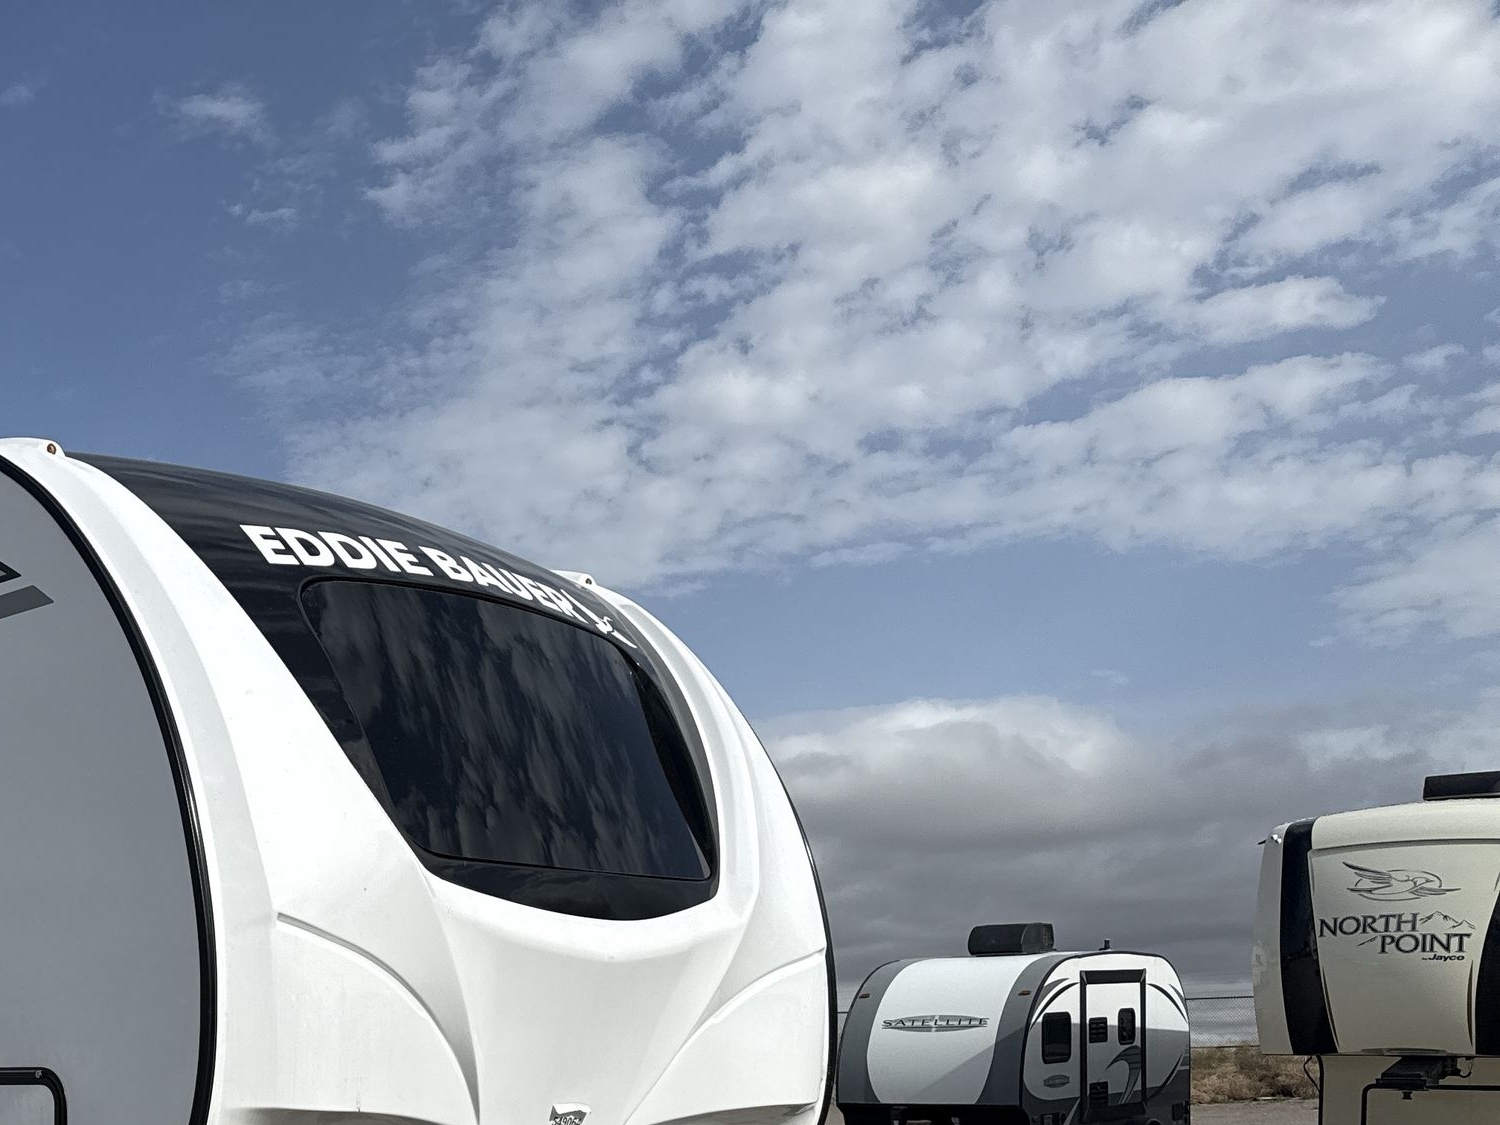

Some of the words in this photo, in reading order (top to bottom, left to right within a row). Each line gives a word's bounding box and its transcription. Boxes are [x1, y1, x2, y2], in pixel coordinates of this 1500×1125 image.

[240, 524, 435, 577] EDDIE
[419, 546, 588, 624] BAUER
[1318, 912, 1420, 938] NORTH
[1378, 933, 1472, 955] POINT
[1428, 954, 1465, 962] Jayco
[883, 1017, 990, 1028] SATELLITE
